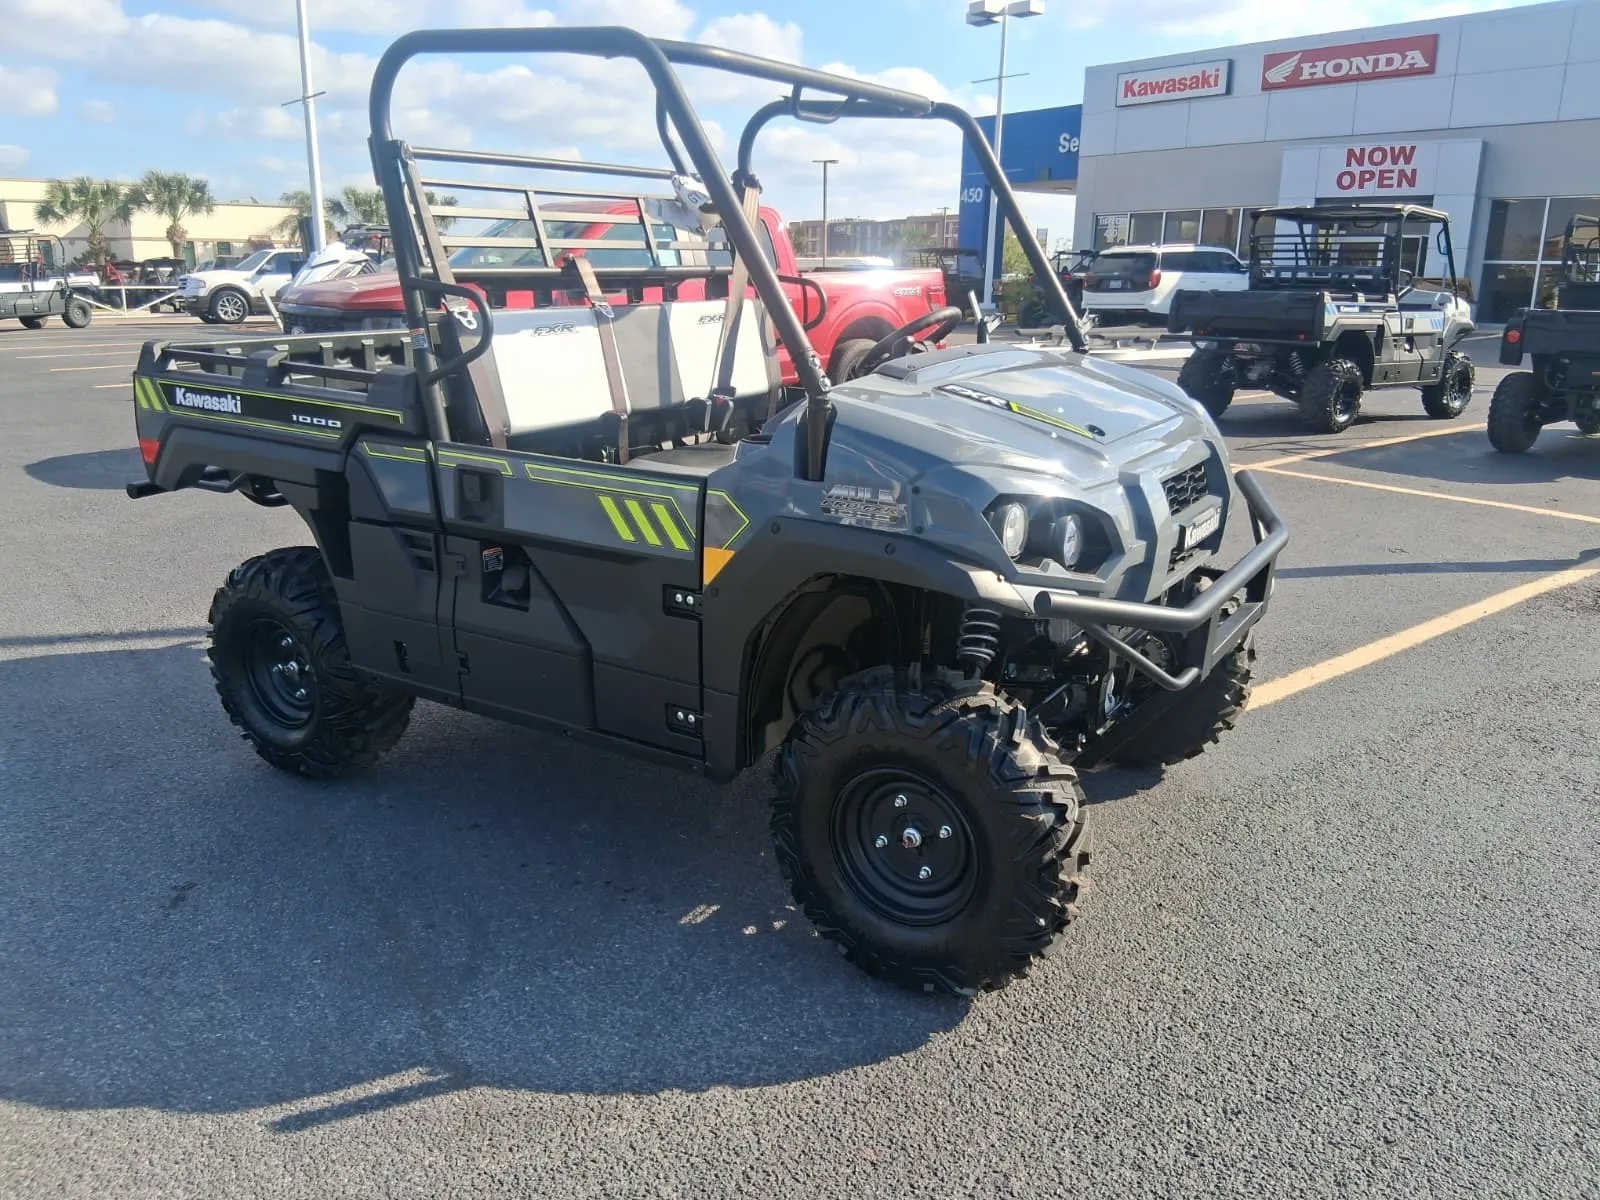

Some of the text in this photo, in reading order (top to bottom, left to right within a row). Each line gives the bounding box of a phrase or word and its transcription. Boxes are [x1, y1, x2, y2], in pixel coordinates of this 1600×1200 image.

[1299, 49, 1429, 81] HONDA
[1123, 67, 1221, 99] Kawasaki
[1345, 145, 1417, 168] NOW
[1335, 167, 1418, 191] OPEN
[175, 387, 242, 414] Kawasaki
[291, 413, 342, 429] 1000
